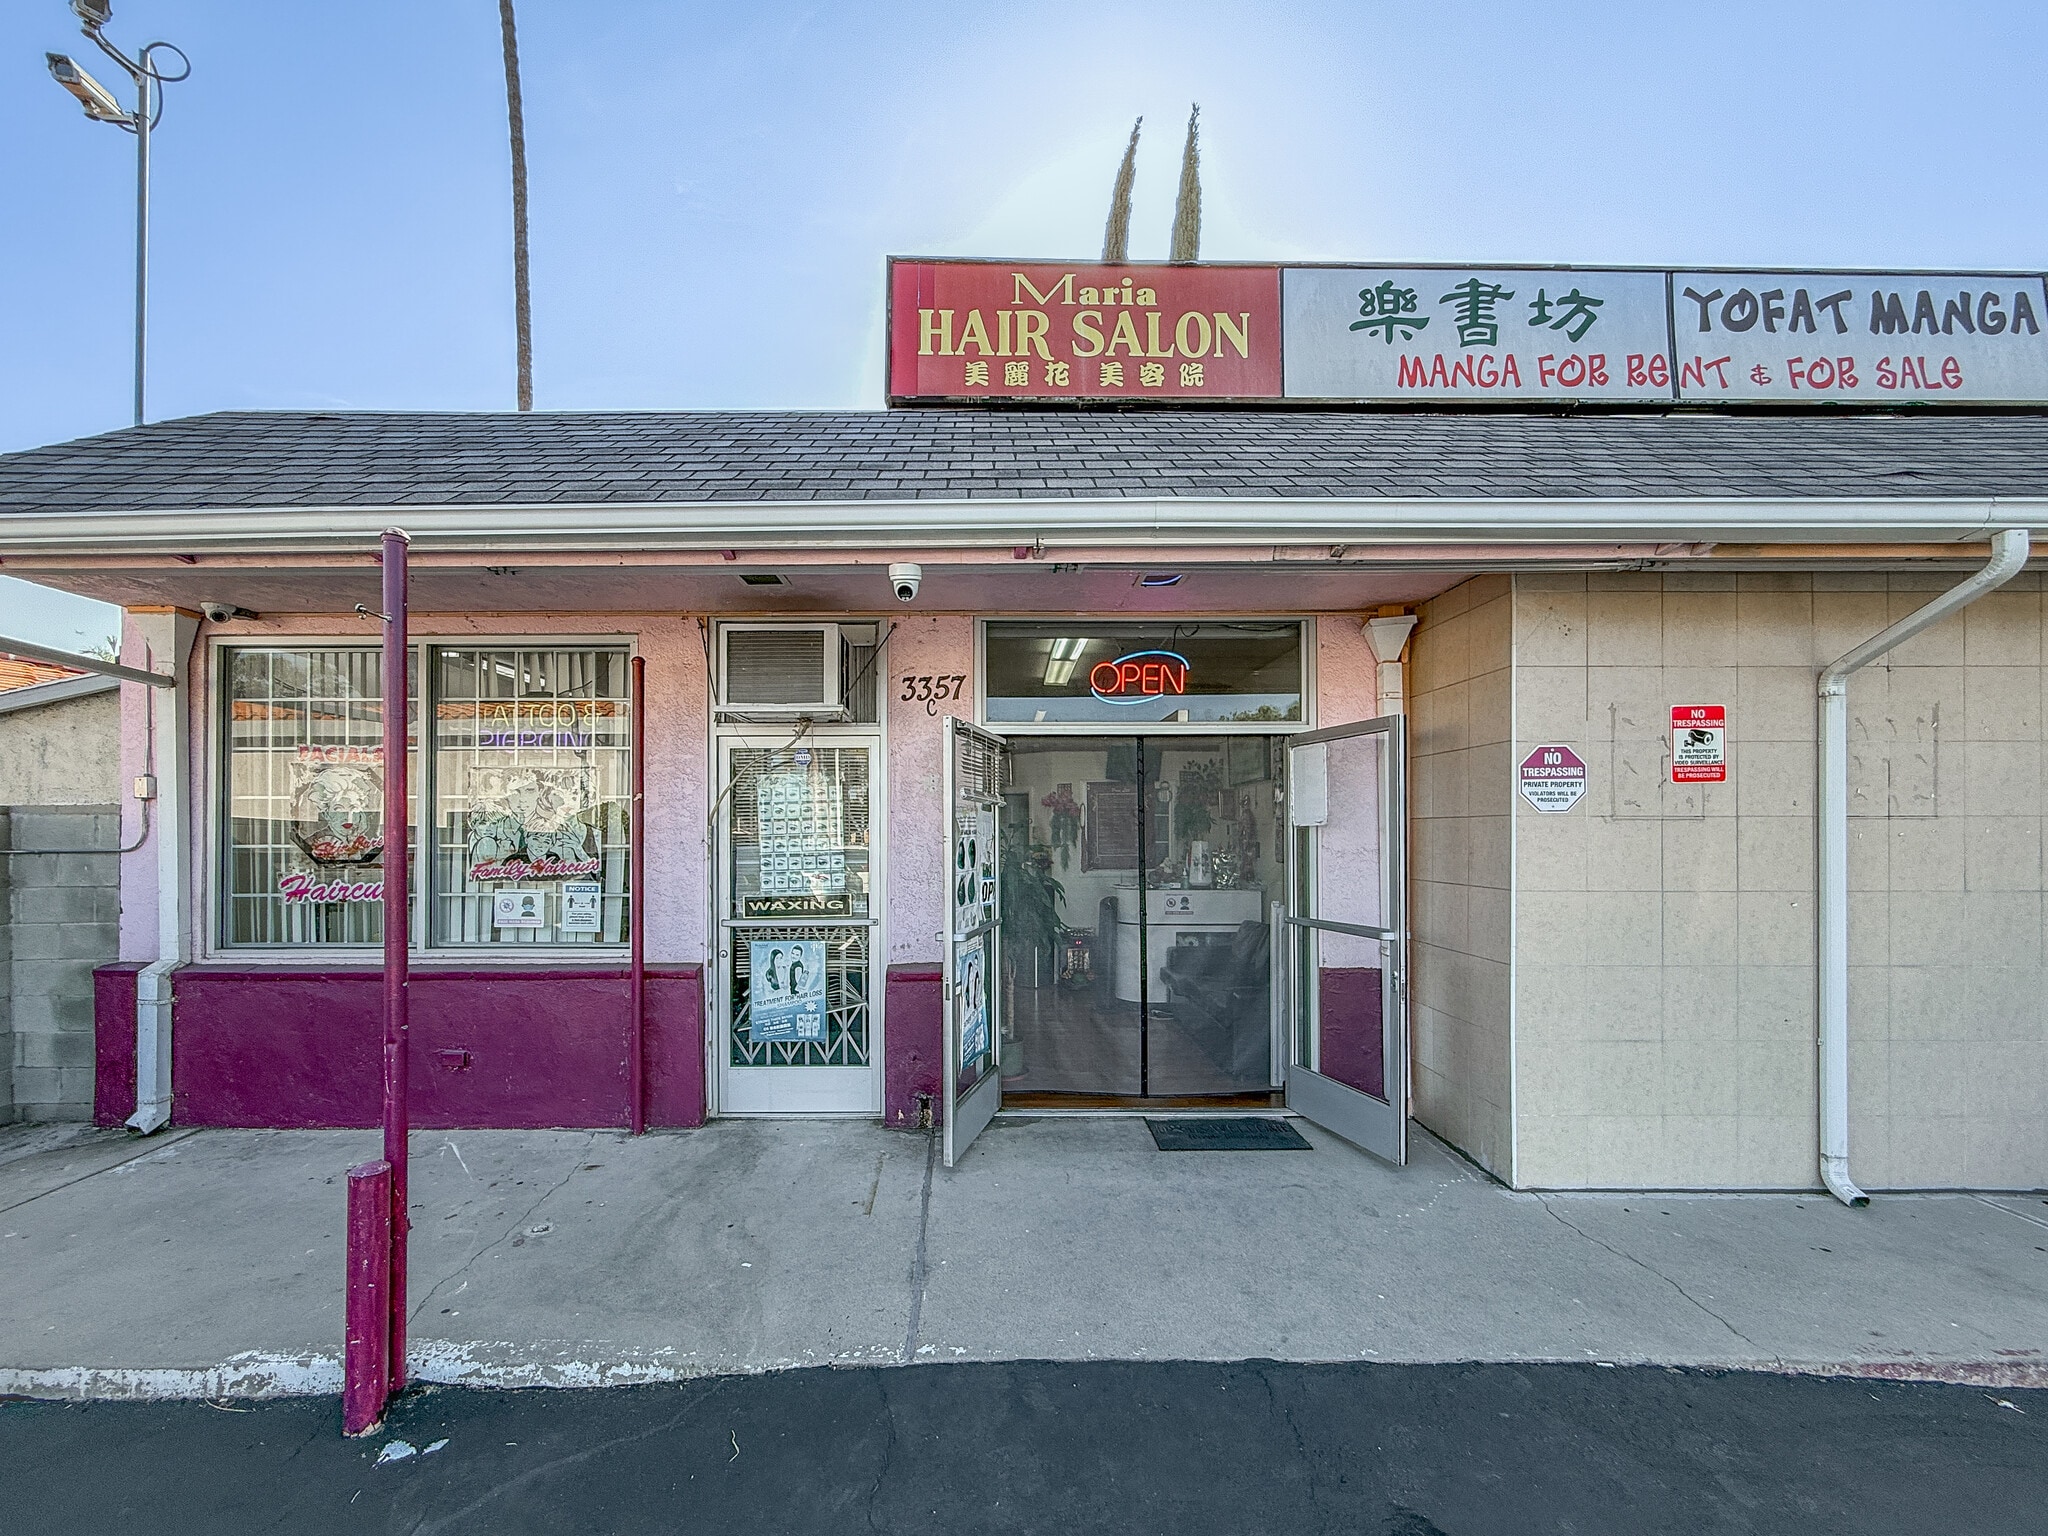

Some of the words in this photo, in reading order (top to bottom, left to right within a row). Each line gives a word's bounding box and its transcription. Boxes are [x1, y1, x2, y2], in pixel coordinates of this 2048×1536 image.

[1010, 272, 1157, 306] Maria
[1349, 277, 1605, 348] 樂書坊
[1683, 287, 1852, 335] YOFAT
[1869, 289, 2041, 336] MANGA
[917, 308, 1055, 361] HAIR
[1071, 310, 1250, 359] SALON
[964, 360, 1070, 387] 美麗花
[1099, 361, 1205, 388] 美容院
[1397, 353, 1522, 388] MANGA
[1537, 353, 1610, 388] FOR
[1750, 363, 1773, 387] &
[1786, 356, 1860, 390] FOR
[901, 674, 966, 701] 3357
[1090, 661, 1185, 694] OPEN
[926, 698, 938, 717] C
[1690, 709, 1706, 719] NO
[1673, 719, 1724, 727] TRESPASSING
[1522, 767, 1584, 777] TRESPASSING
[1544, 752, 1562, 765] NO
[470, 859, 529, 880] Family
[529, 856, 600, 877] Haircuts
[279, 875, 384, 903] Haircu
[748, 900, 844, 911] WAXING
[754, 996, 784, 1007] TREATMENT
[784, 994, 795, 1002] FOR
[809, 989, 823, 998] LOSS
